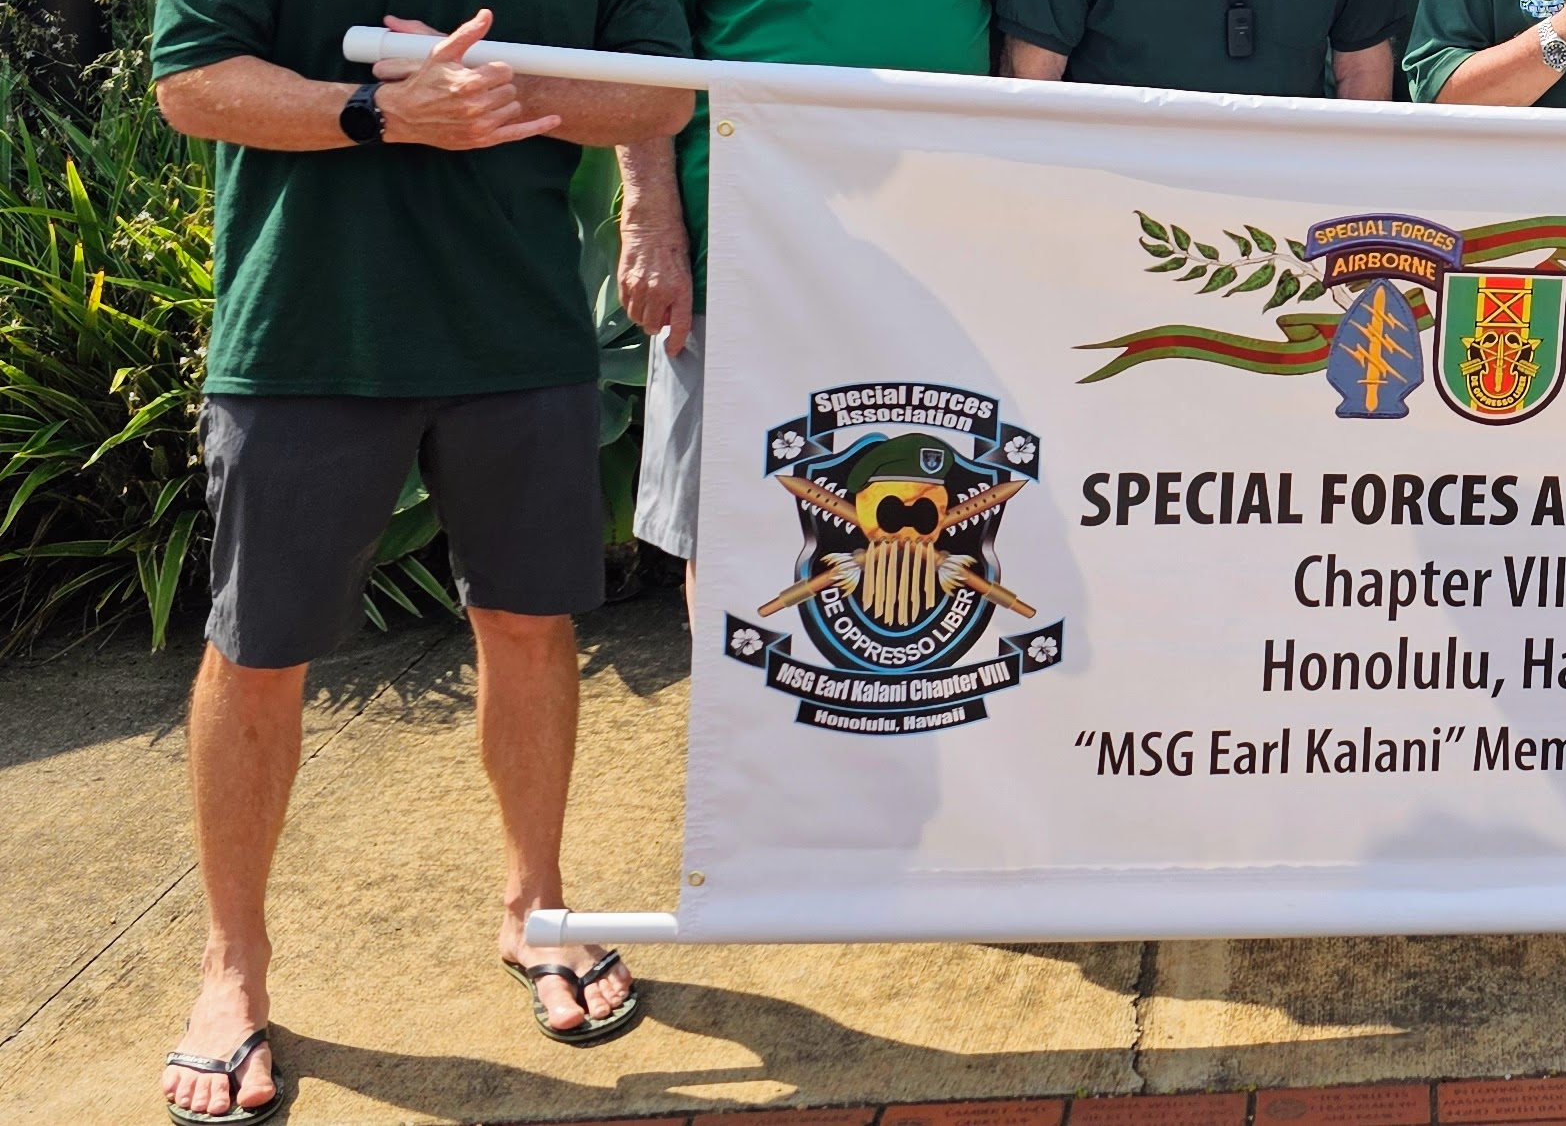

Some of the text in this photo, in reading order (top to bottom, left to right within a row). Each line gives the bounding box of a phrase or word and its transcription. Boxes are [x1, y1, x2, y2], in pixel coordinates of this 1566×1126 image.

[1314, 219, 1456, 251] SPECIAL FORCES
[1331, 252, 1437, 281] AIRBORNE
[814, 385, 994, 419] Special Forces
[1473, 387, 1515, 407] OPPRESSO
[836, 406, 973, 432] Association
[1081, 472, 1302, 527] SPECIAL
[1320, 473, 1519, 529] FORCES
[1294, 553, 1492, 622] Chapter
[820, 587, 976, 665] DE OPPRESSO LIBER
[775, 661, 1011, 703] MSG Earl Kalani Chapter VIII
[1262, 636, 1505, 699] Honolulu,
[813, 706, 966, 733] Honolulu, Hawaii
[1074, 730, 1194, 777] “MSG
[1209, 728, 1291, 775] Earl
[1305, 727, 1466, 774] Kalani”
